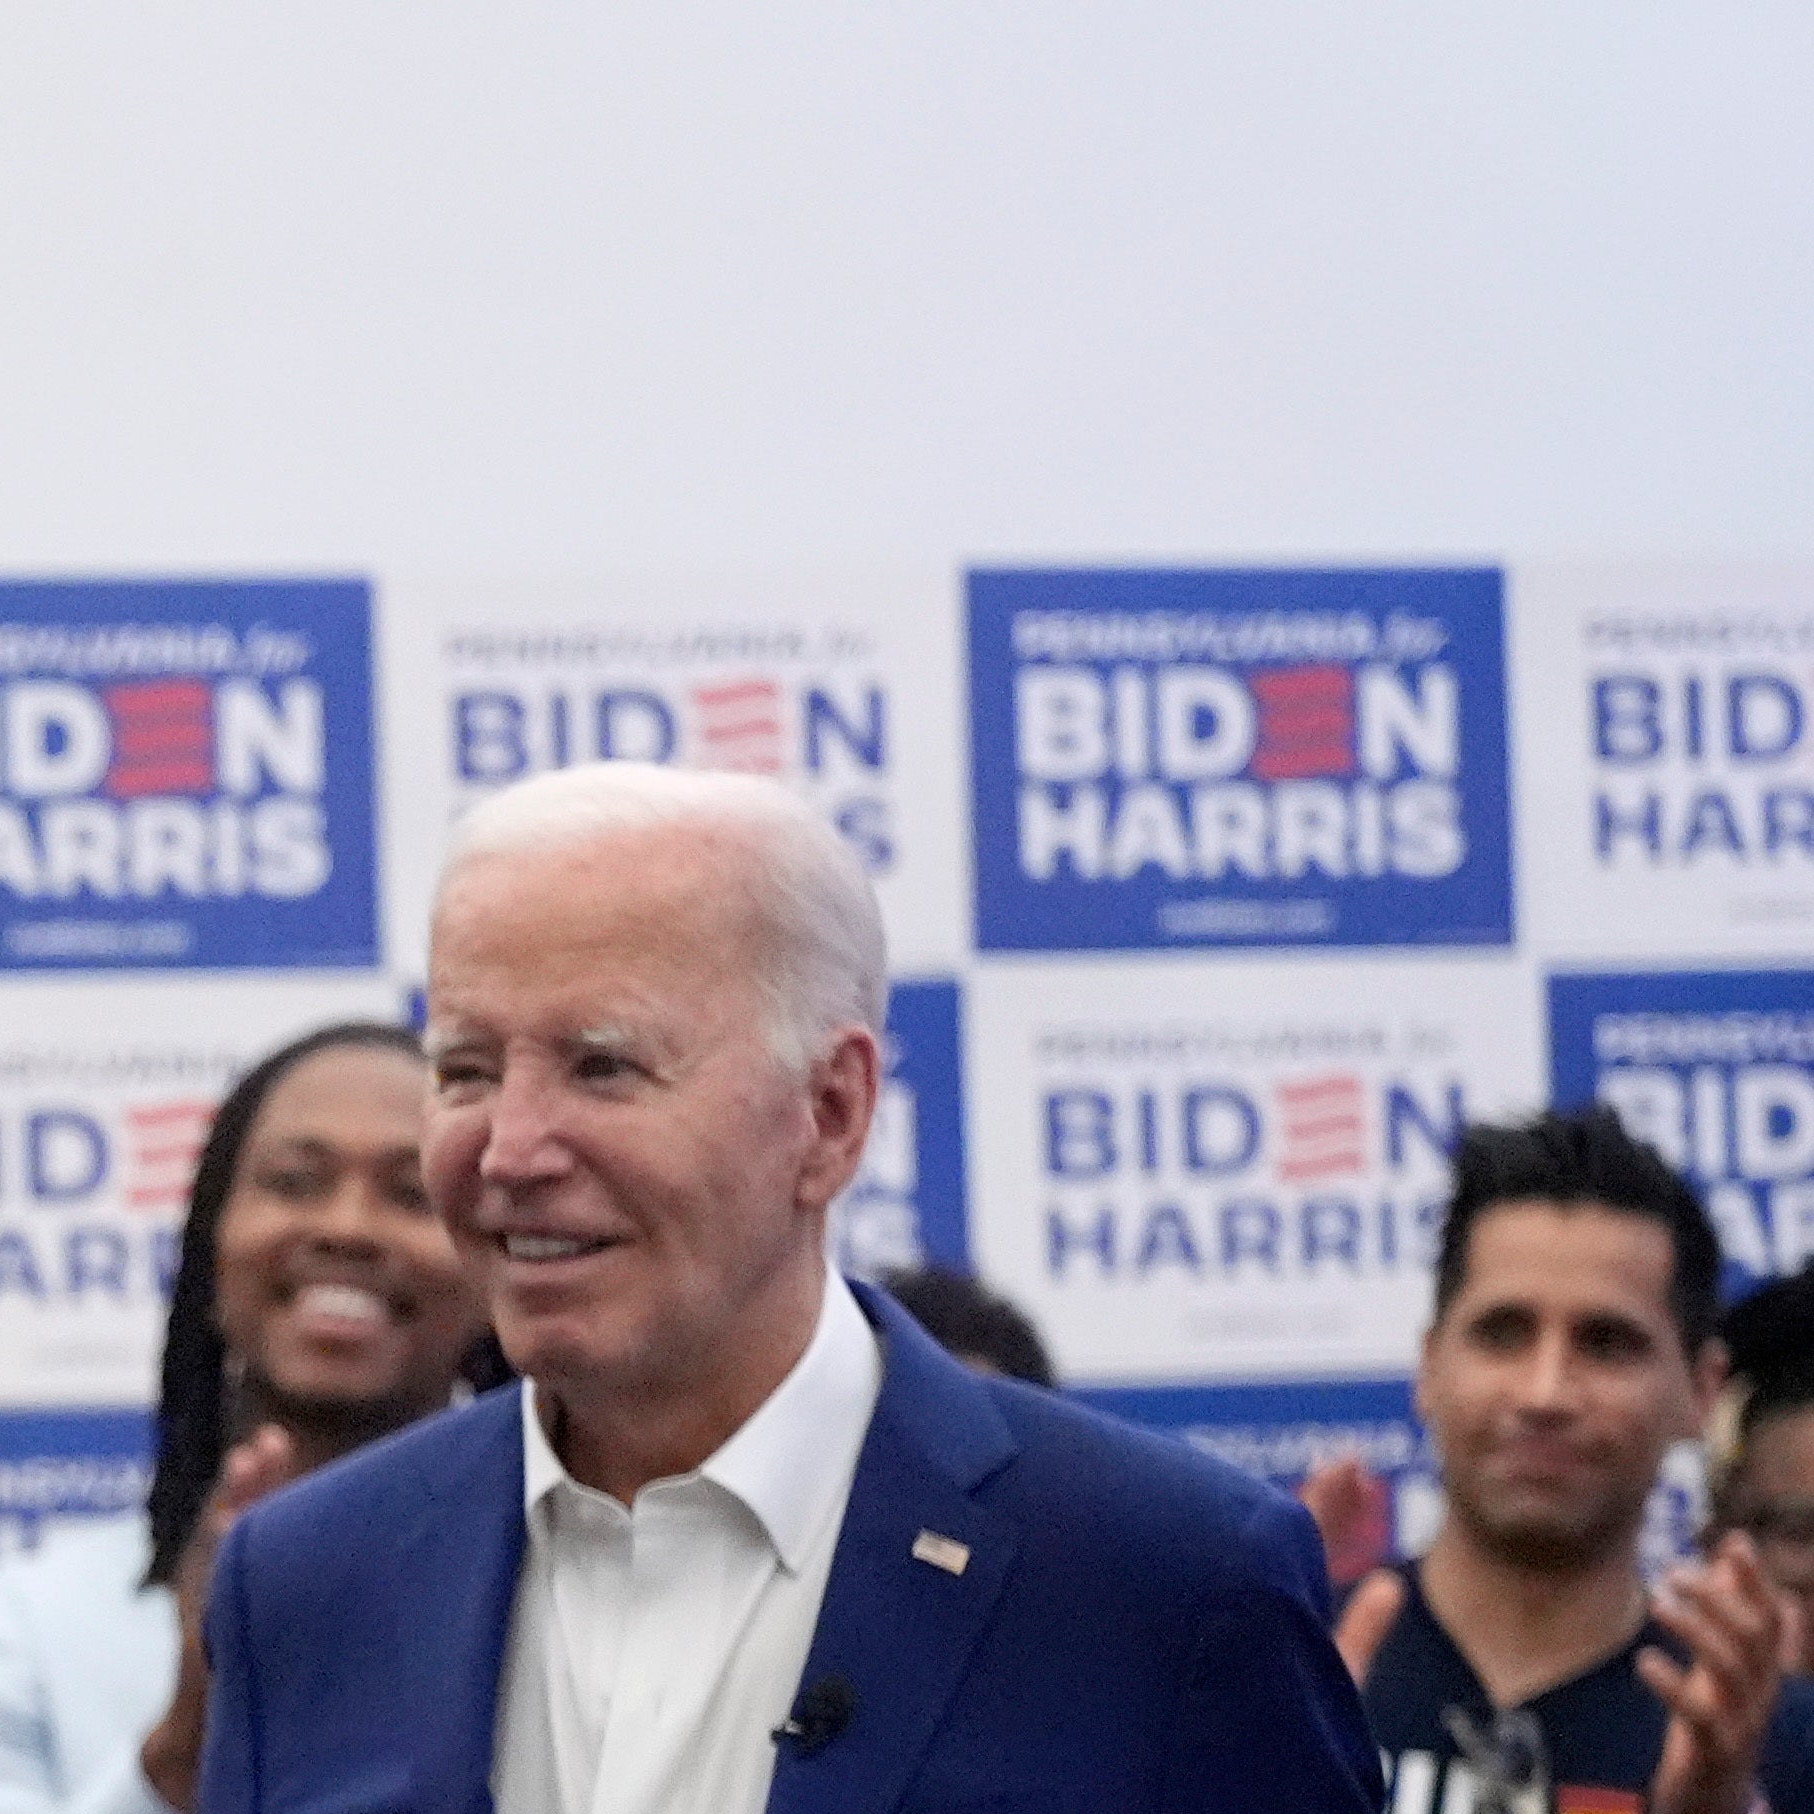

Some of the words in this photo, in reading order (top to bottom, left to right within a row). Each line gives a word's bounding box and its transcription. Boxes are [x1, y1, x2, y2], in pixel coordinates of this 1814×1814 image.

[452, 677, 886, 783] BIDEN
[1014, 662, 1459, 781] BIDEN
[1019, 779, 1468, 880] HARRIS
[1043, 1074, 1465, 1181] BIDEN
